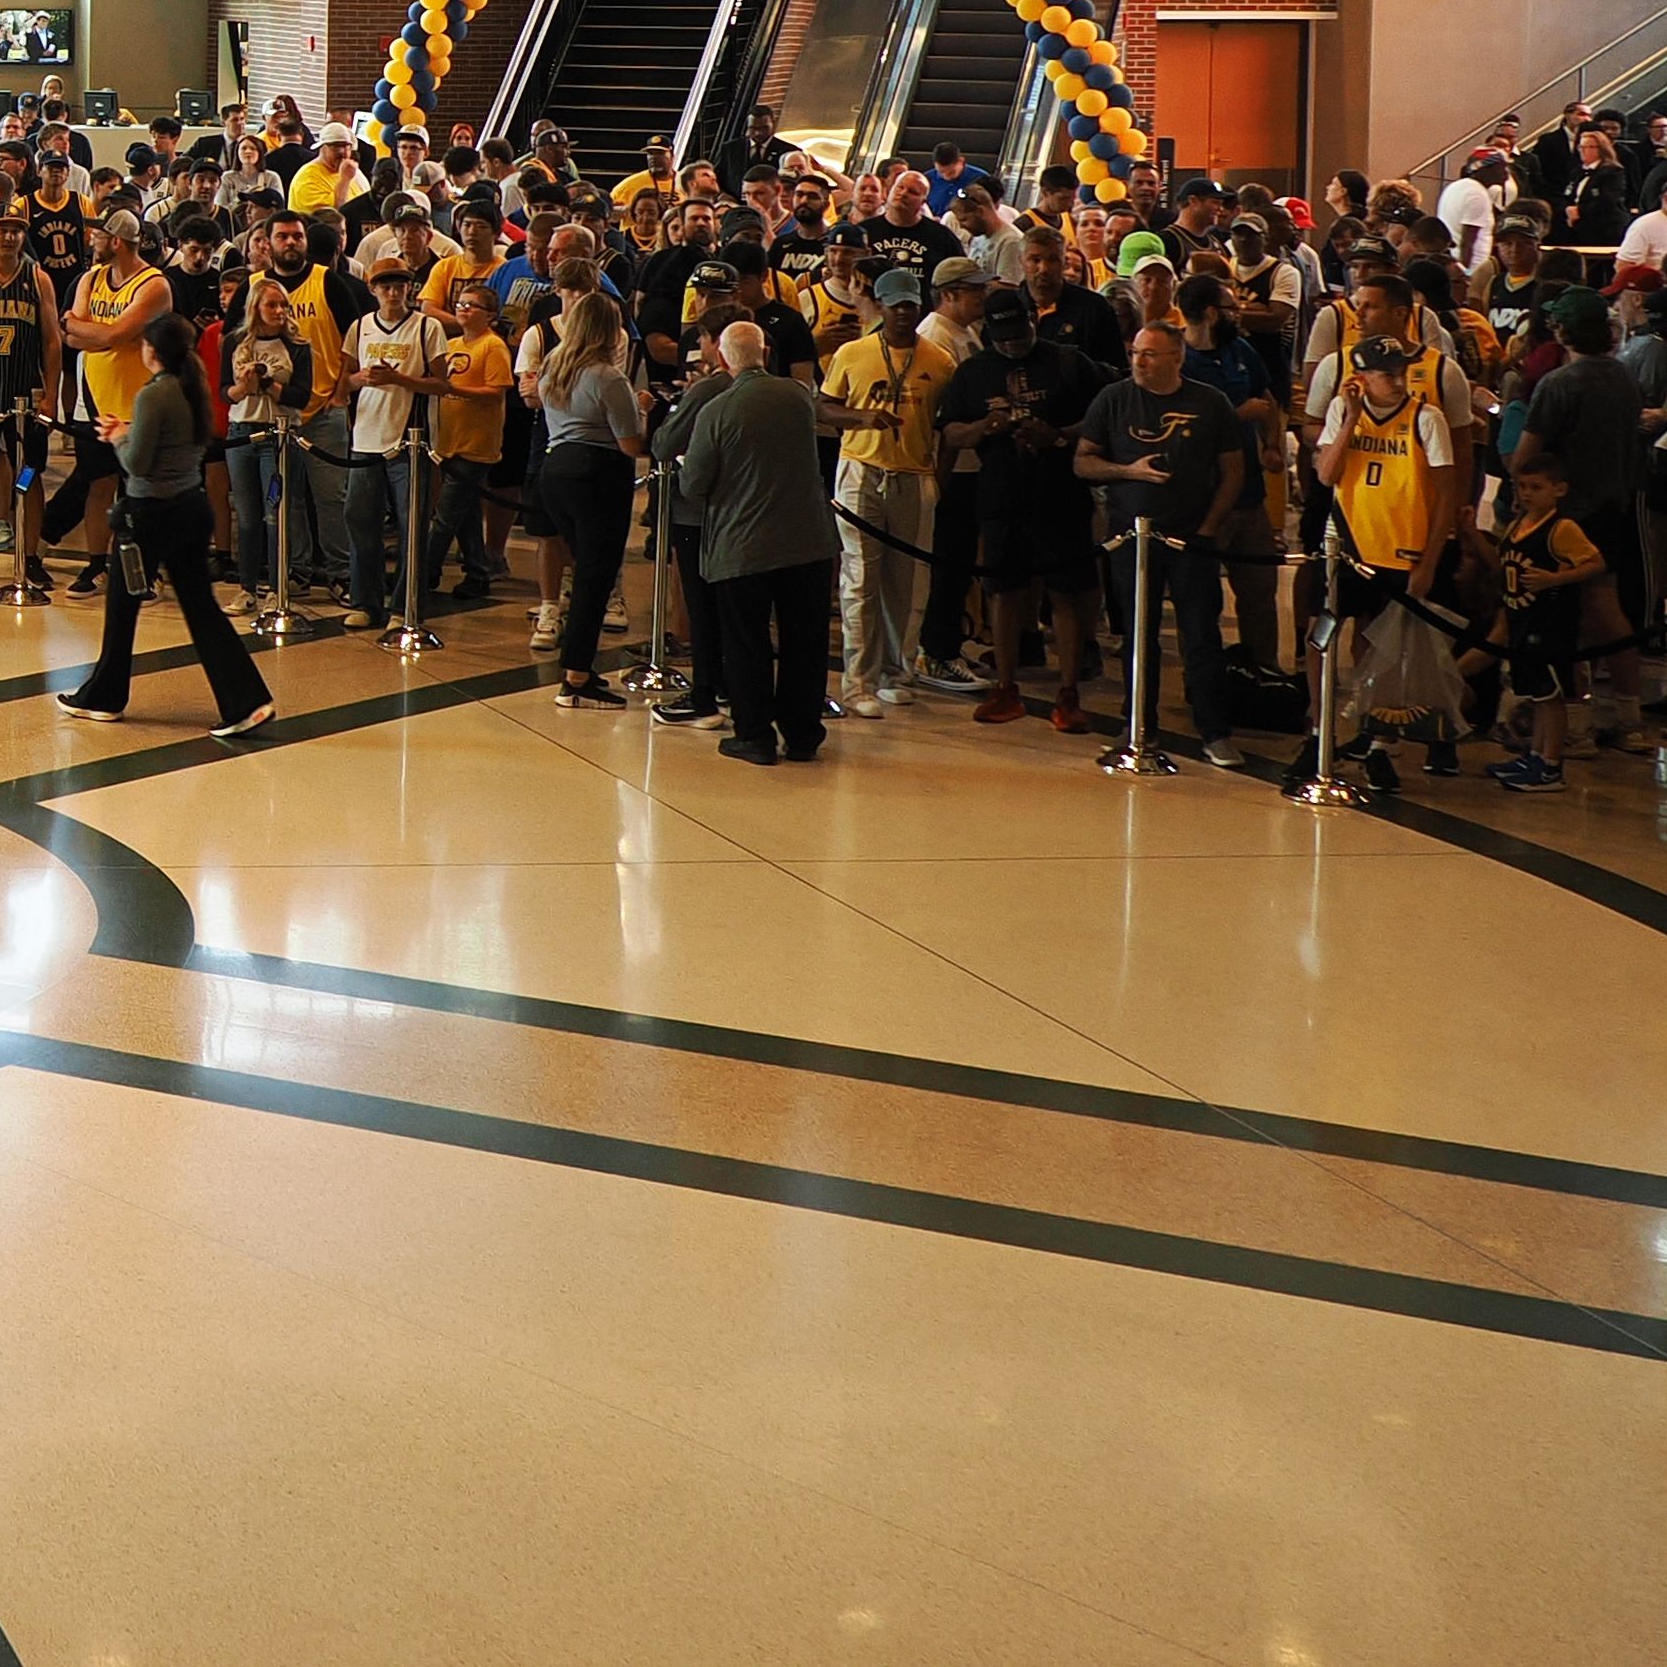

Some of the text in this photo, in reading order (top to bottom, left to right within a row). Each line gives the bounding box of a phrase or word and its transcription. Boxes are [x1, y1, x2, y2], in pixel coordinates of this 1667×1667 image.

[37, 220, 77, 239] INDIANA
[52, 233, 66, 255] 0
[873, 237, 928, 255] PACERS
[780, 252, 826, 271] INDY
[1365, 461, 1383, 486] 0
